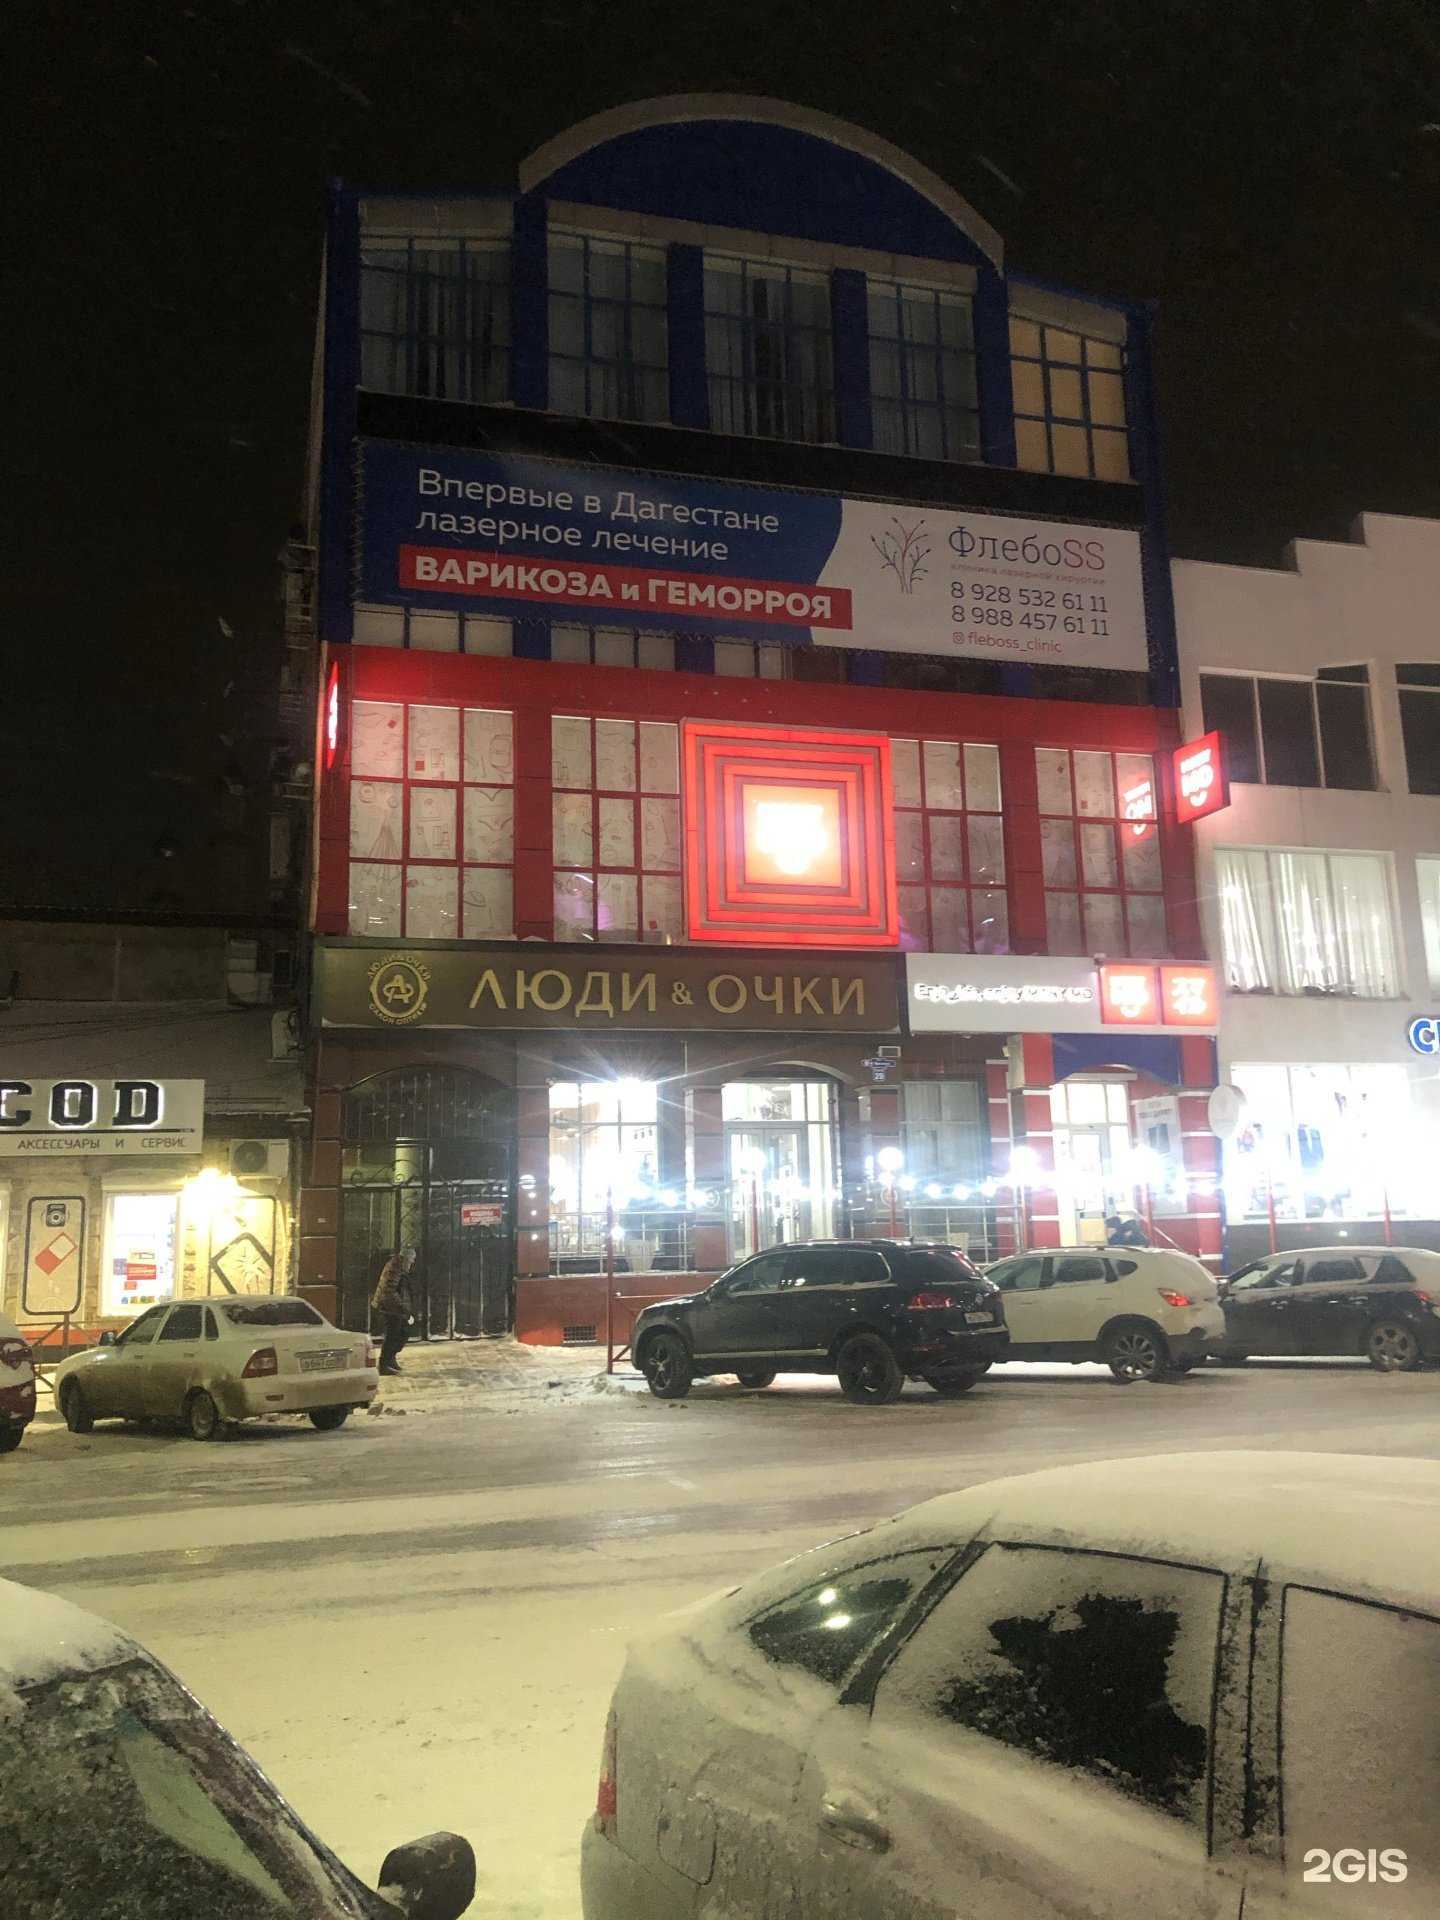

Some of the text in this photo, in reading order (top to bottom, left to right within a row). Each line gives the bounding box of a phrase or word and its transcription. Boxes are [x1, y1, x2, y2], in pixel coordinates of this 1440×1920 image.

[418, 468, 780, 533] Впервые в Дагестане
[416, 511, 729, 561] лазерное лечение
[949, 526, 1105, 571] ФлебоSS
[415, 555, 832, 619] ВАРИКОЗА и ГЕМОРРОЯ
[951, 581, 1108, 613] 8 928 532 61 11
[951, 605, 1110, 636] 8 988 457 61 11
[468, 968, 657, 1019] ЛЮДИ
[671, 980, 694, 1006] &
[707, 974, 865, 1016] ОЧКИ
[17, 1136, 187, 1151] АКСЕССУАРЫ И СЕРВИС
